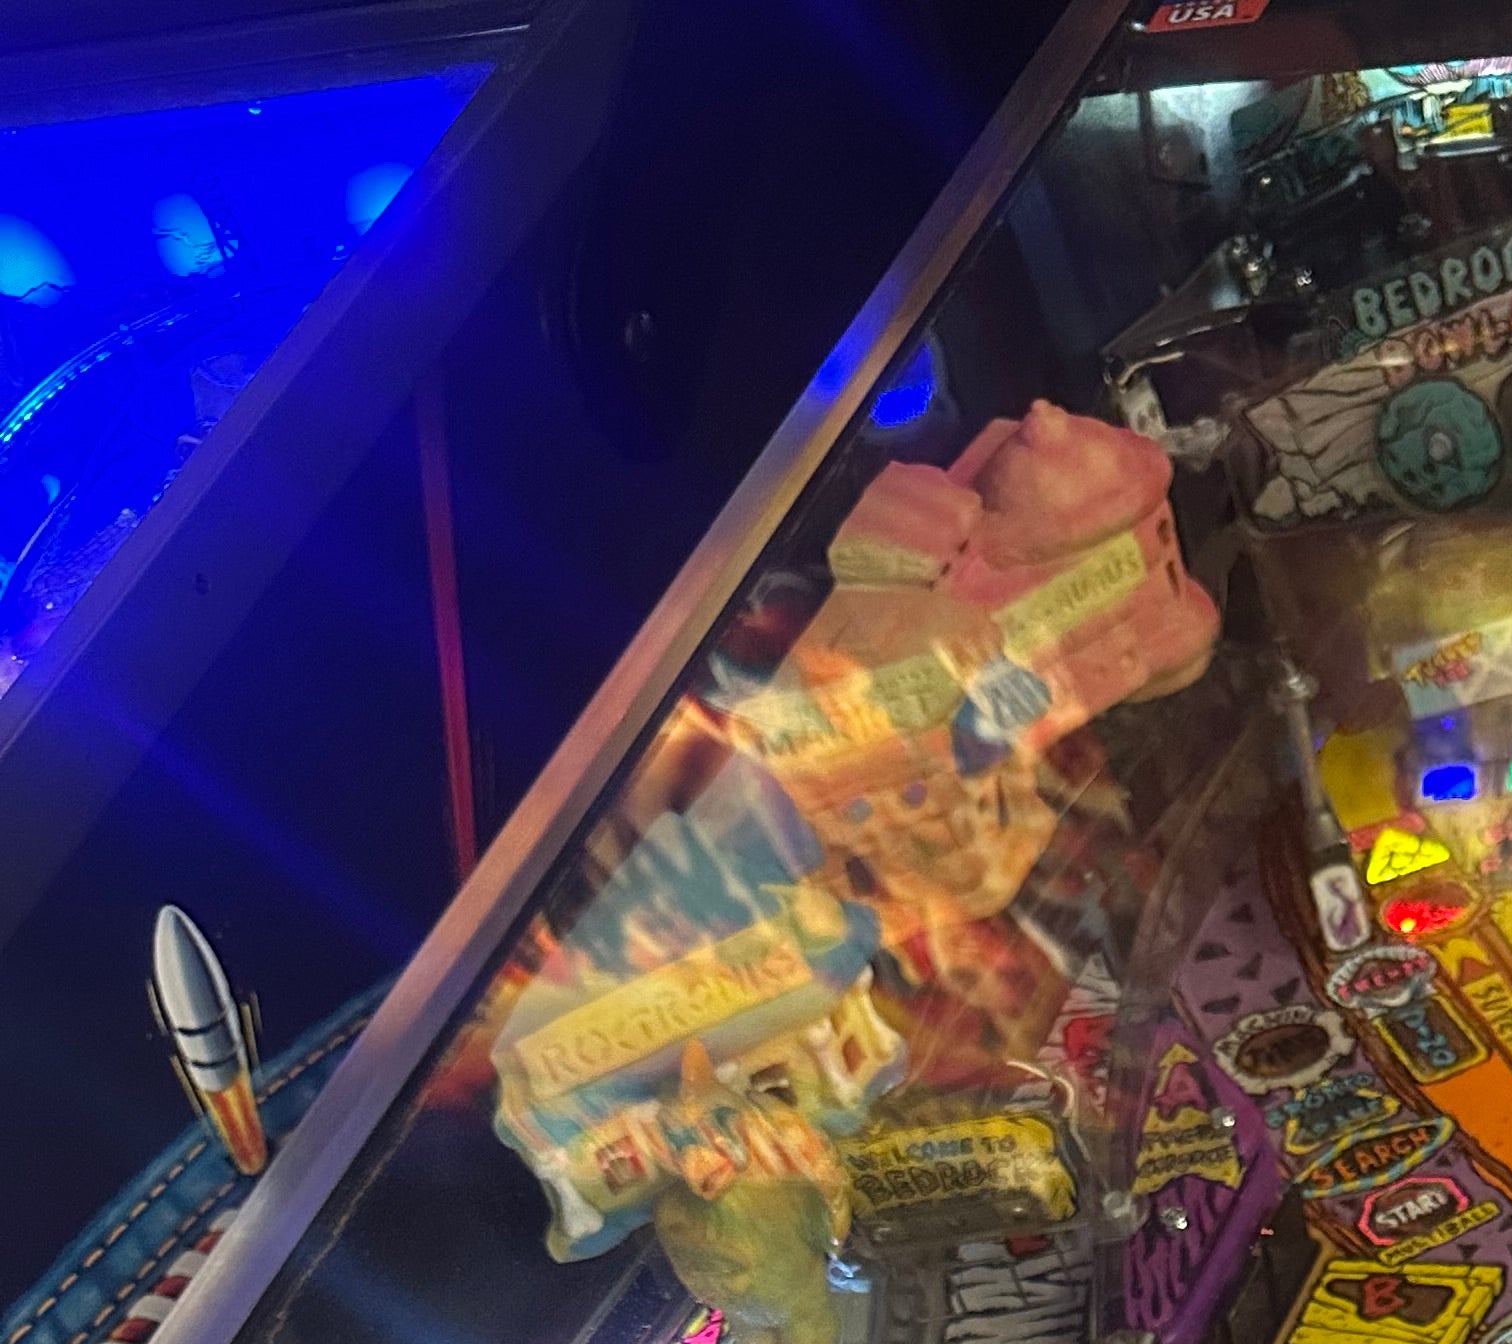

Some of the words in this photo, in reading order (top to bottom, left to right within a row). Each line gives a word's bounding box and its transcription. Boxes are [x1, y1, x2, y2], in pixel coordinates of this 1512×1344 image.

[1168, 4, 1235, 24] USA
[1310, 1126, 1432, 1190] SEARCH
[1373, 1189, 1450, 1231] START
